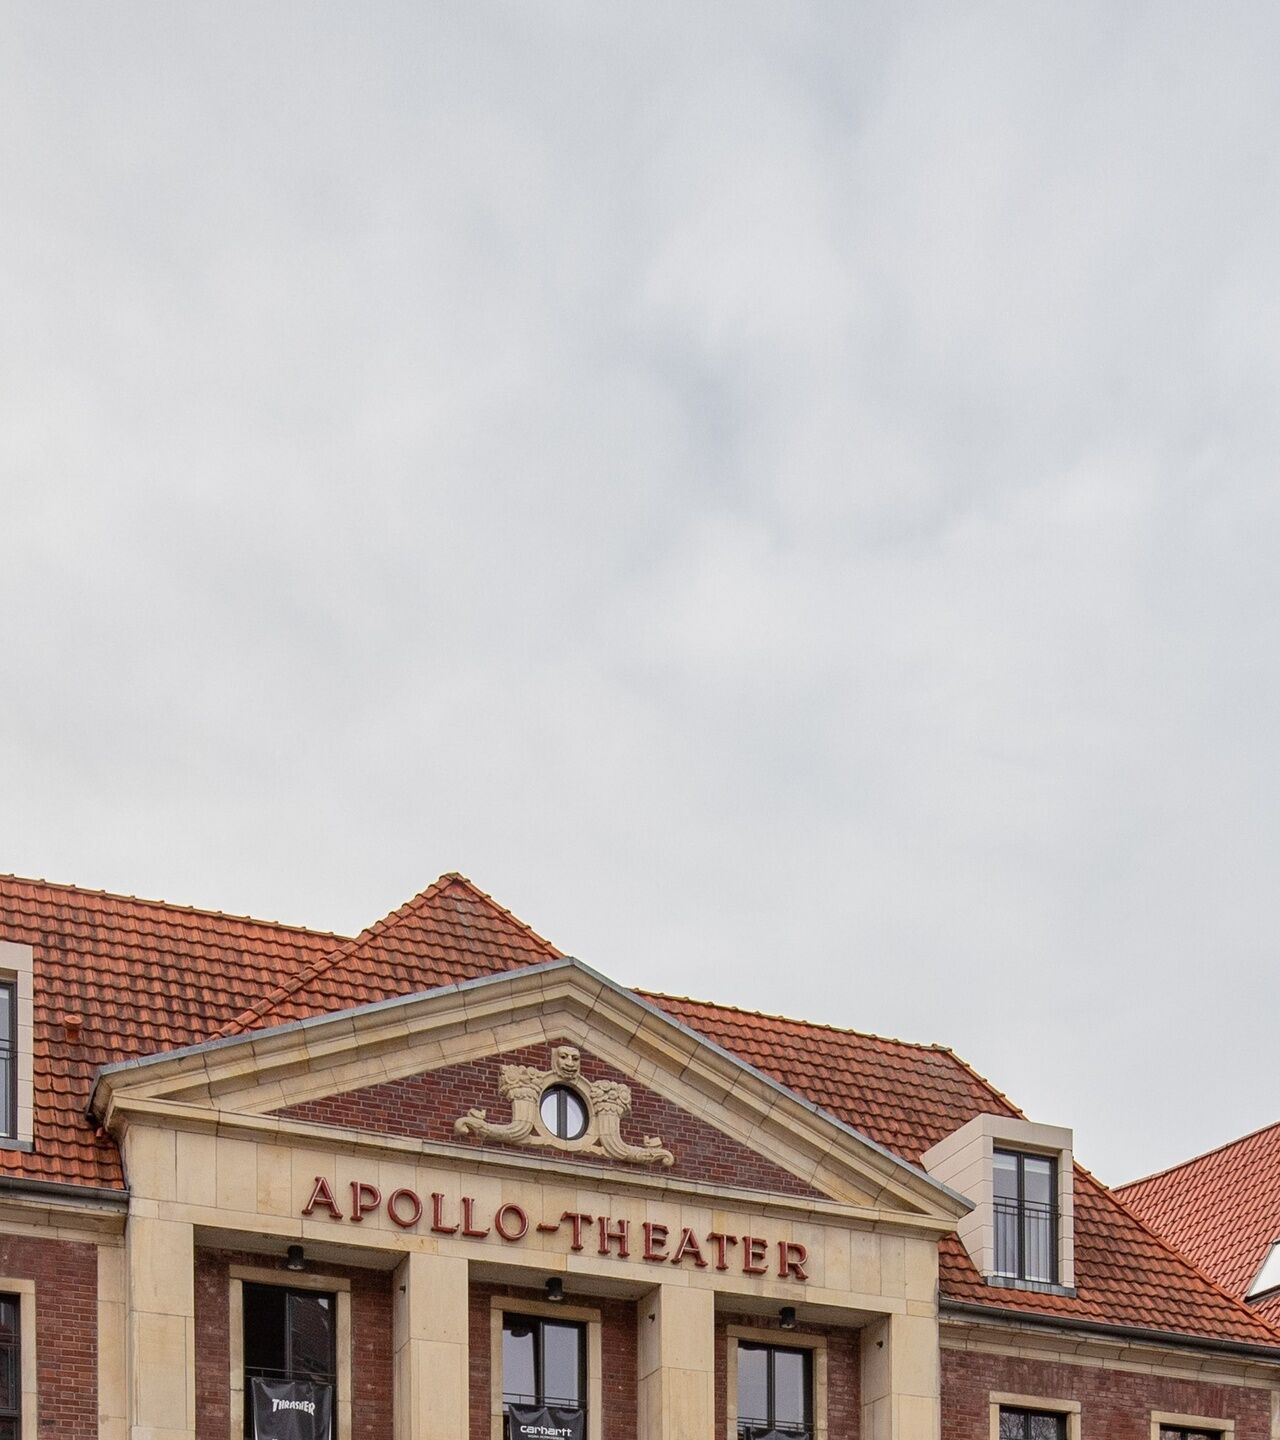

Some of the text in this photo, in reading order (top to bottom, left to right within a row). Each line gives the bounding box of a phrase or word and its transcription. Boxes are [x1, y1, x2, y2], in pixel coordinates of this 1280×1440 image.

[301, 1176, 809, 1280] APOLLO-THEATER
[271, 1398, 316, 1416] THRASHER
[520, 1425, 572, 1437] carhartt
